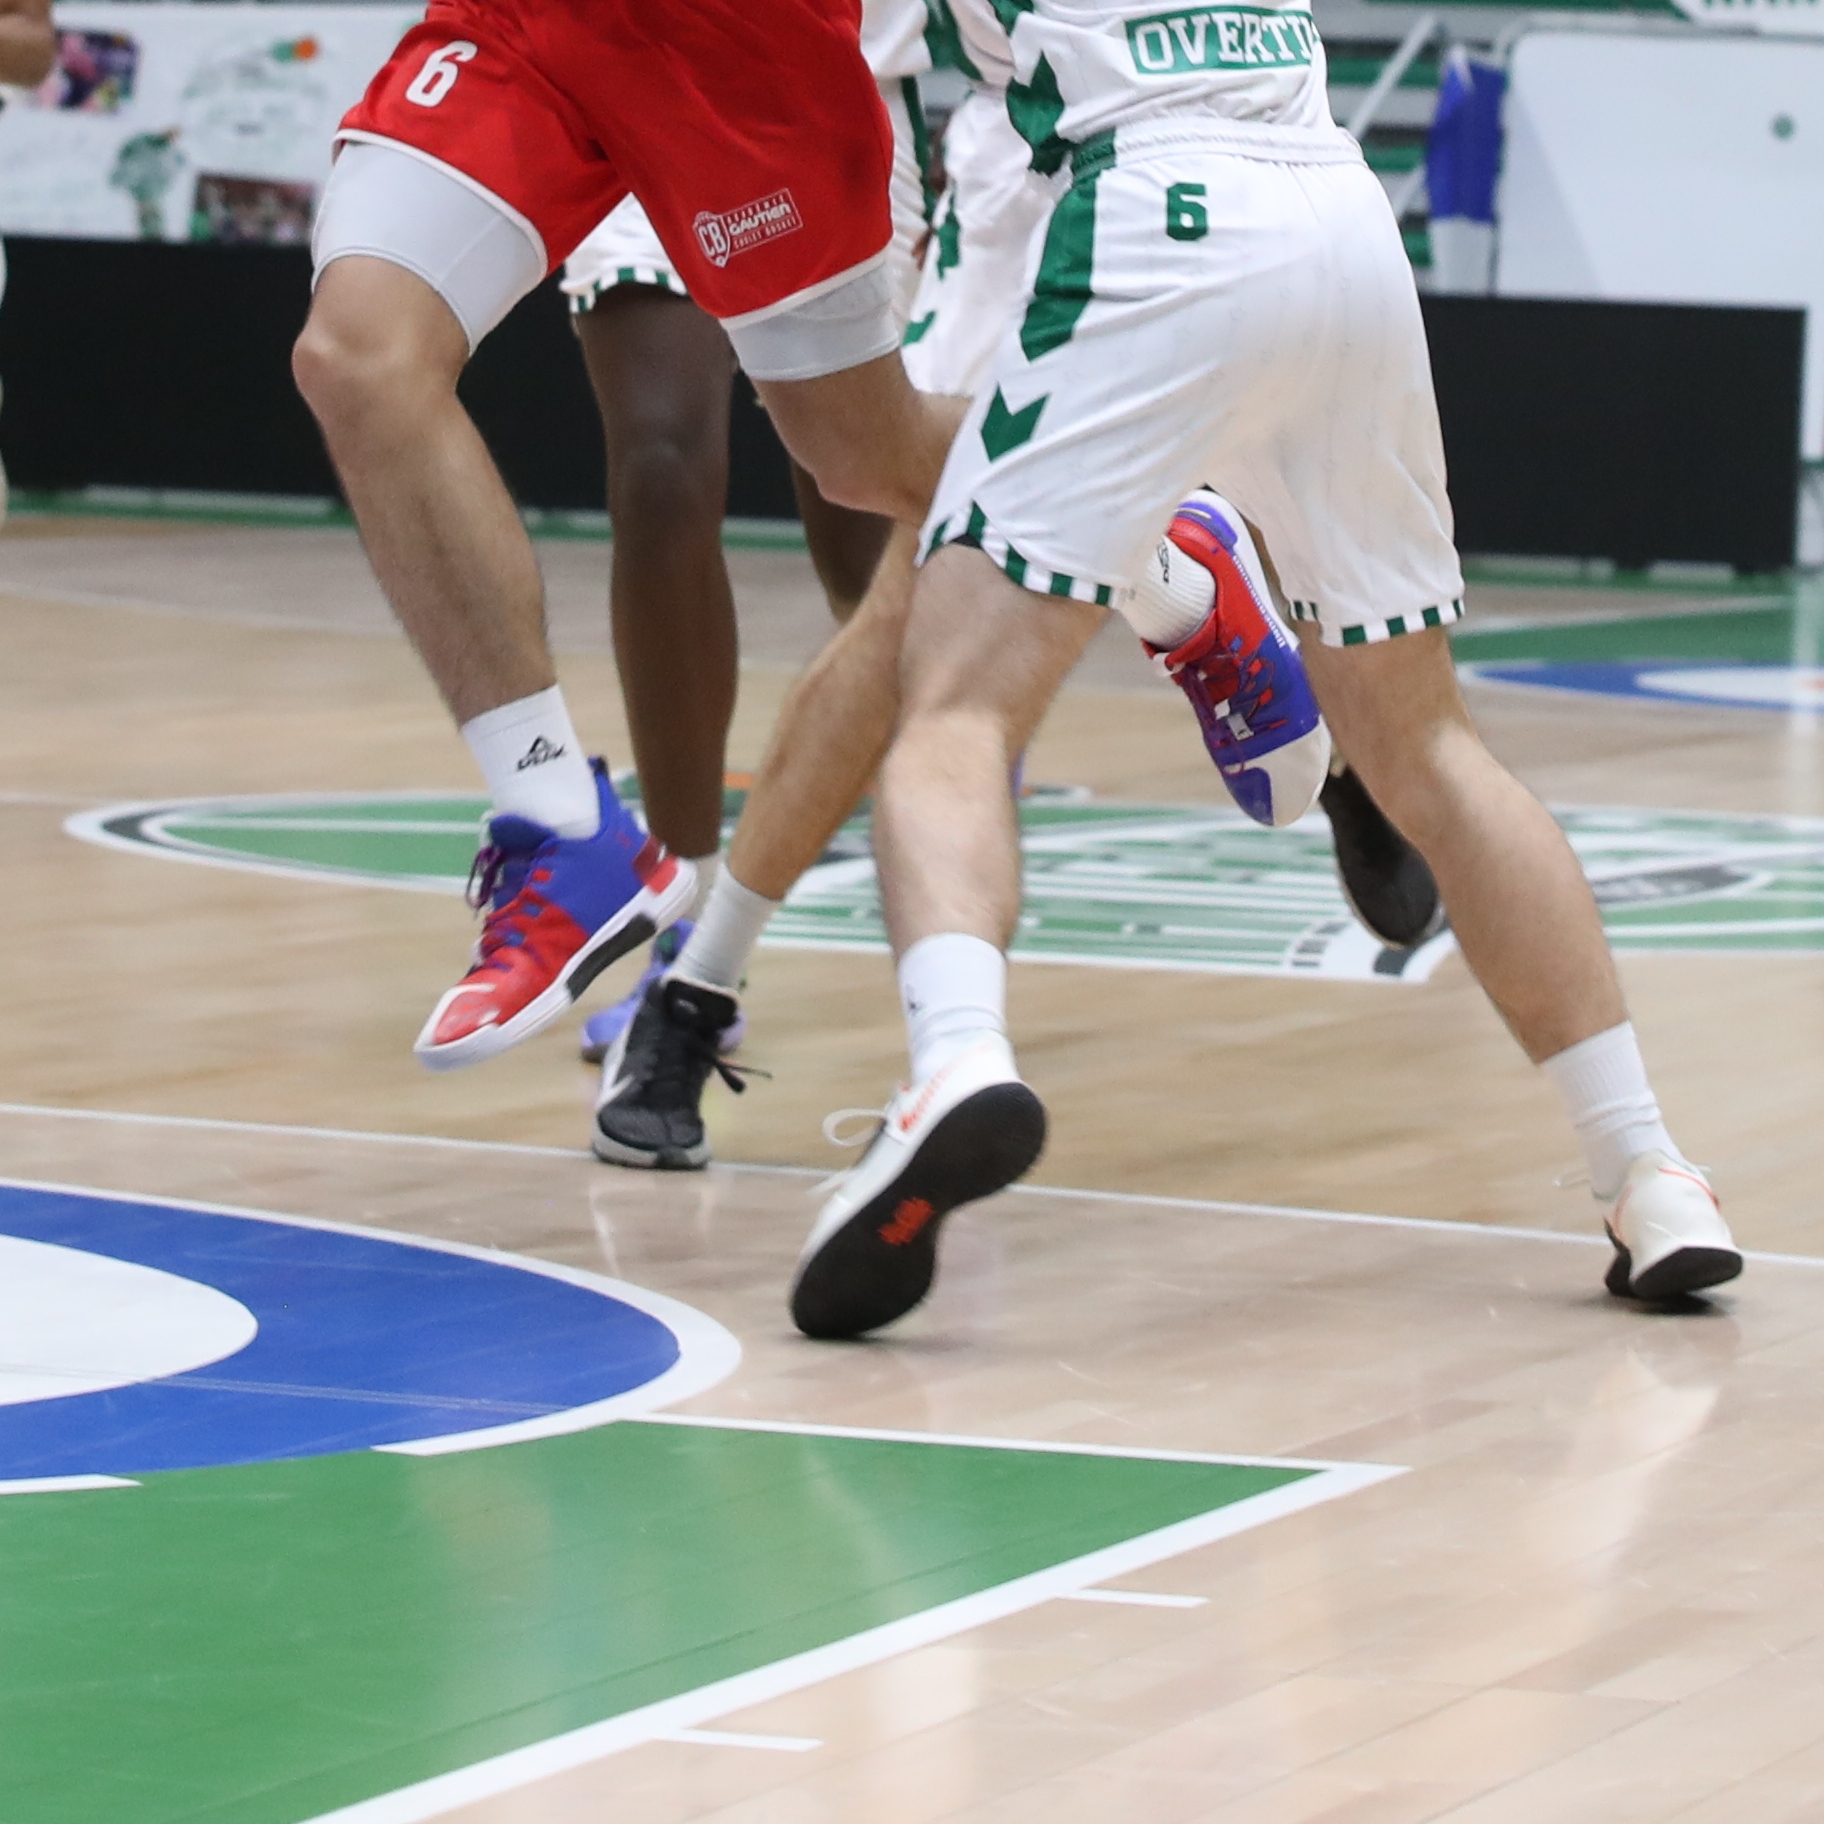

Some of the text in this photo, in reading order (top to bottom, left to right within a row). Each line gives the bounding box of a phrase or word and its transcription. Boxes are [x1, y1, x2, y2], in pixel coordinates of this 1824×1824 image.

[405, 40, 479, 108] 6
[698, 221, 727, 257] CB
[1166, 182, 1208, 242] 6
